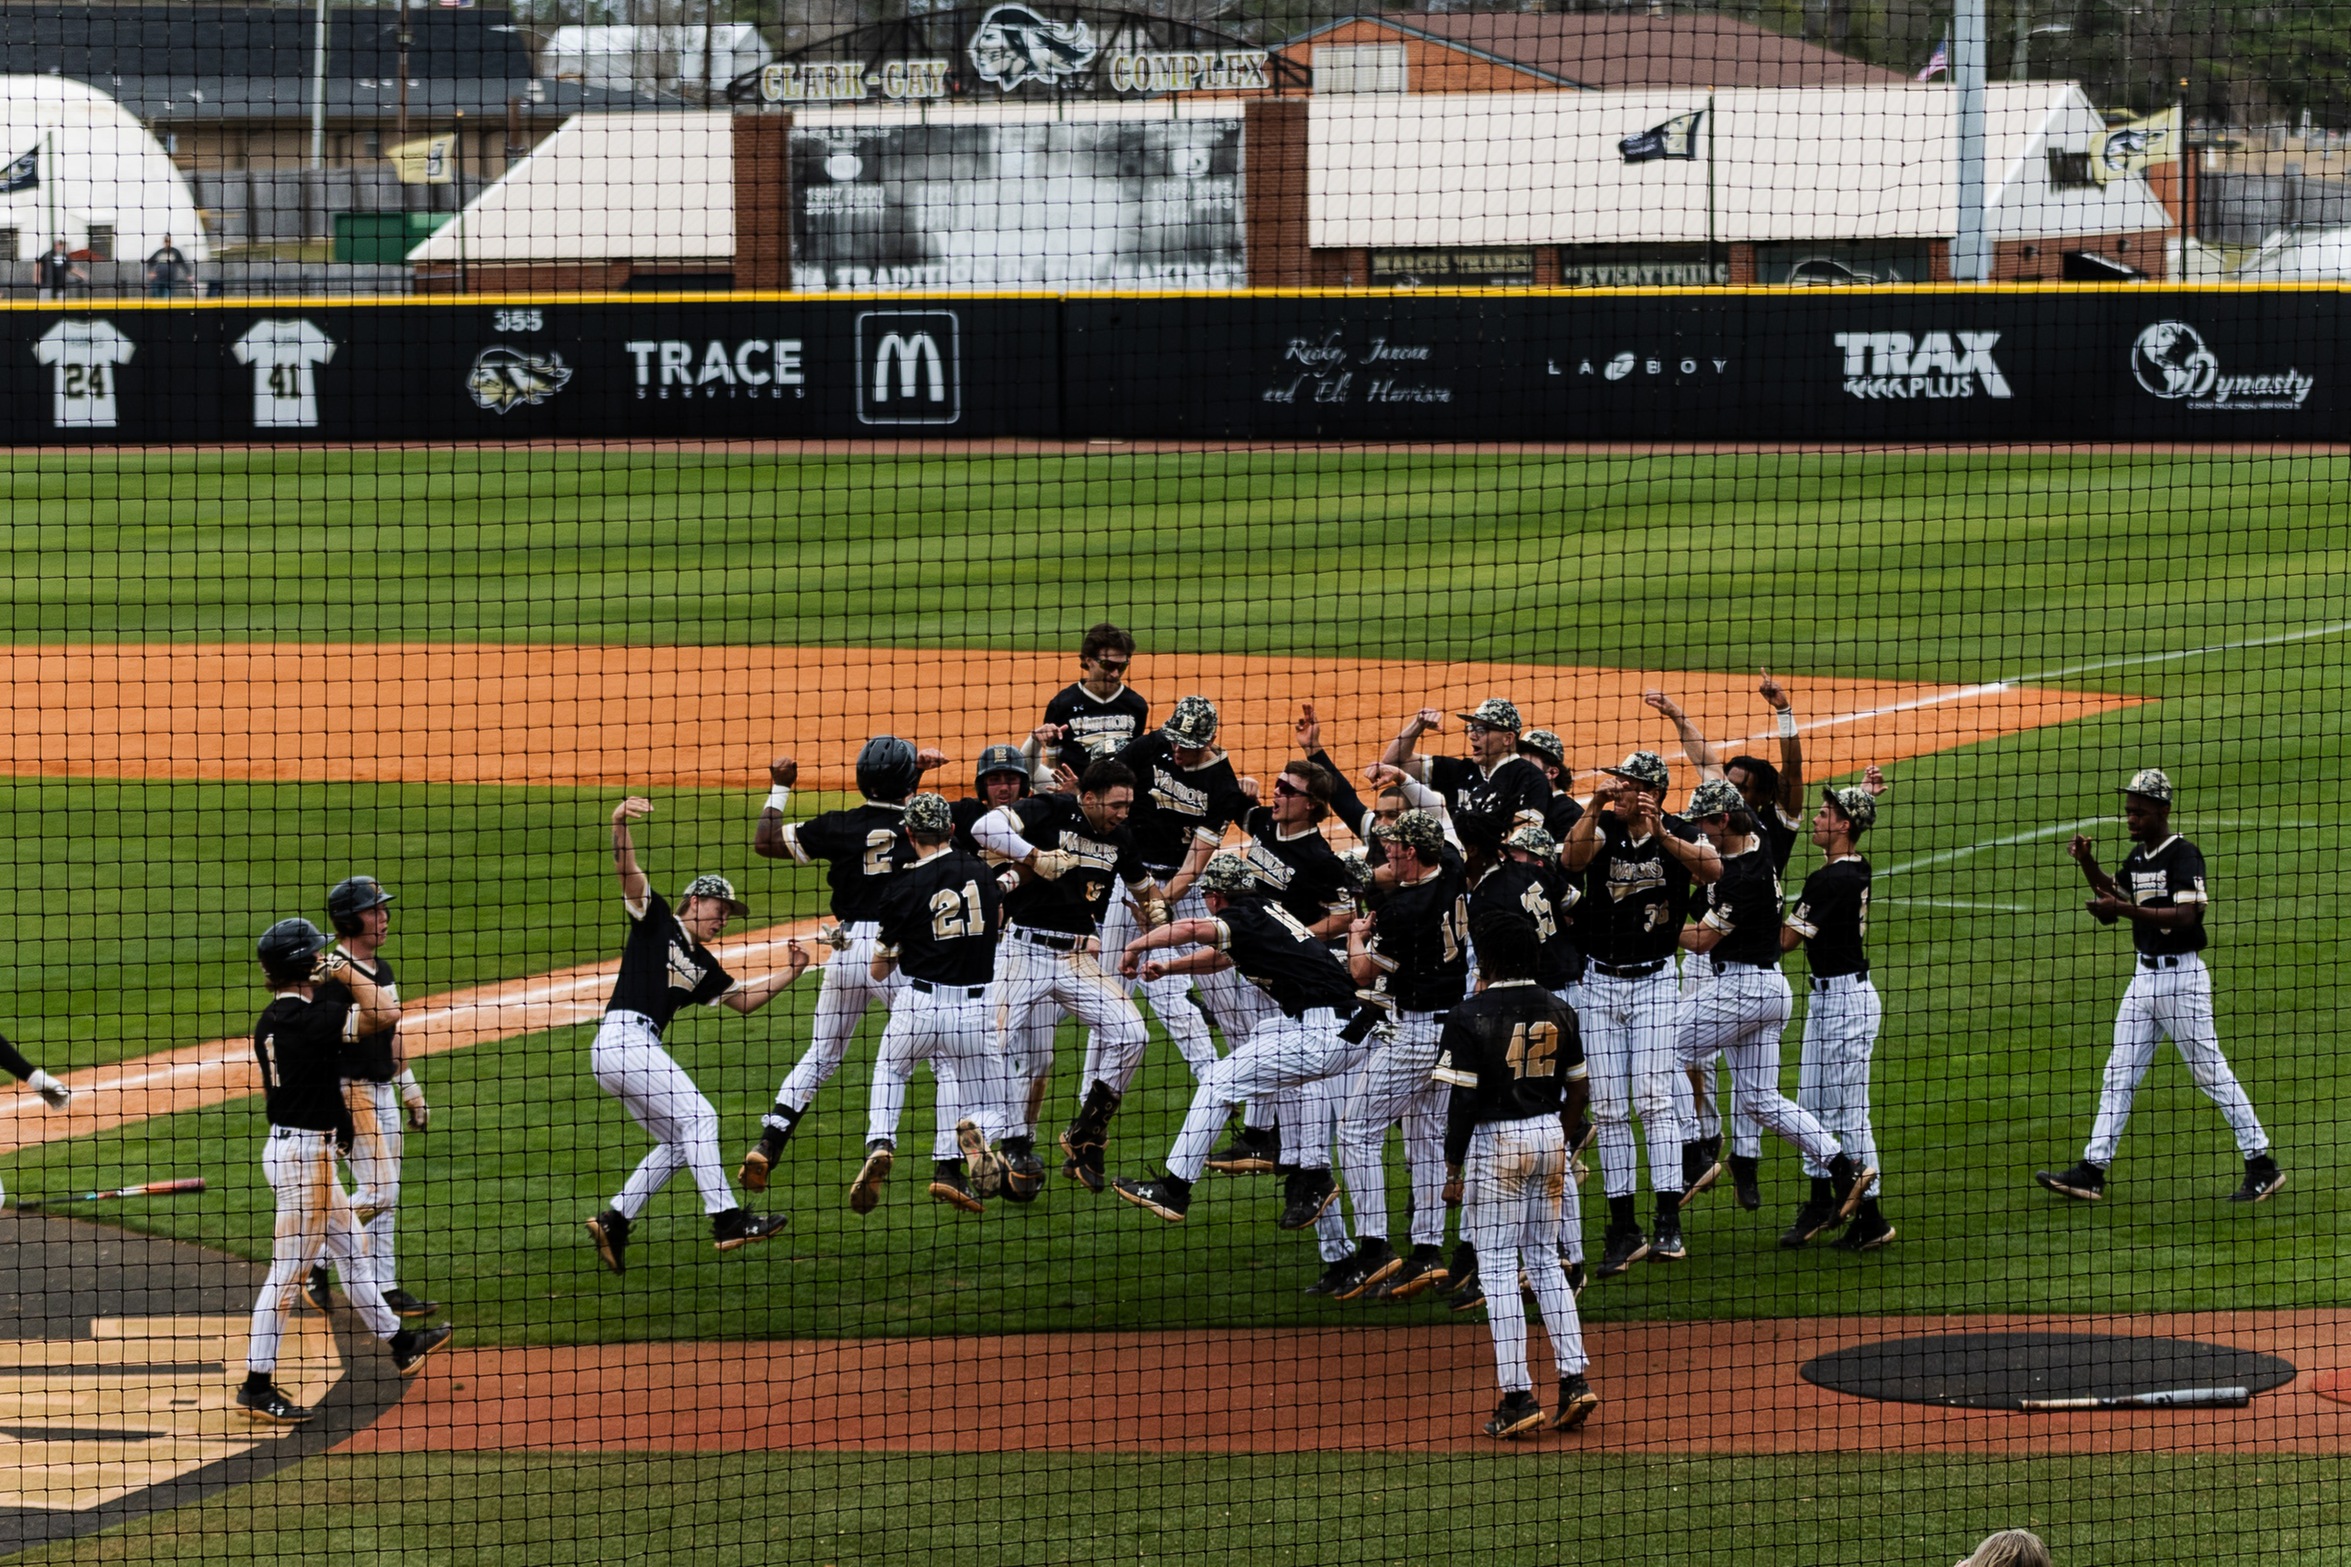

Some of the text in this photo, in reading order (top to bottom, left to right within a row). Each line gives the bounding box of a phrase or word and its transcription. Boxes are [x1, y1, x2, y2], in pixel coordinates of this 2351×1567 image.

[761, 50, 1270, 102] CLARK-GAY COMPLEX
[493, 309, 544, 332] 355
[66, 363, 105, 399] 24
[267, 363, 301, 399] 41
[625, 339, 804, 387] TRACE
[1834, 331, 2014, 399] TRAX
[2178, 350, 2314, 403] Dynasty
[1910, 376, 1974, 399] PLUS
[863, 829, 898, 876] 2
[929, 879, 985, 941] 21
[1505, 1021, 1559, 1081] 42
